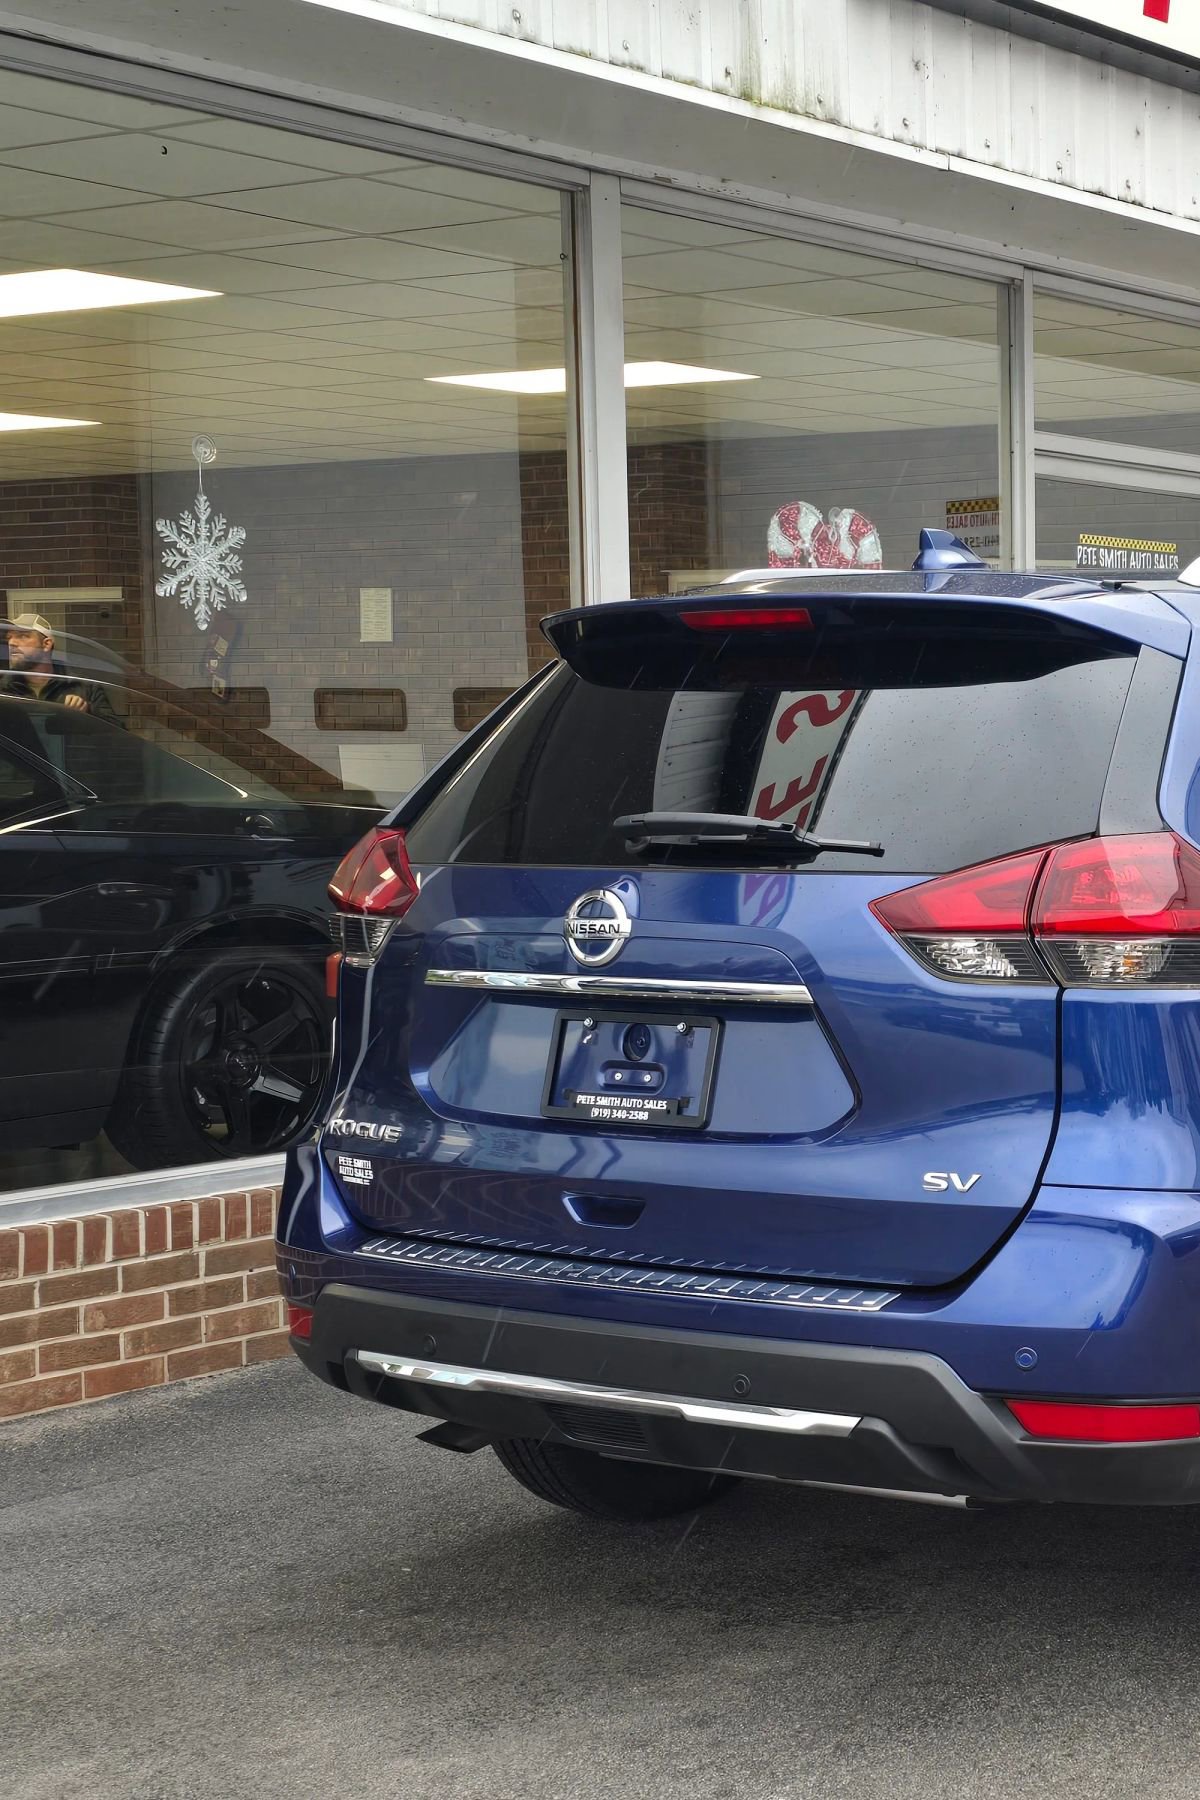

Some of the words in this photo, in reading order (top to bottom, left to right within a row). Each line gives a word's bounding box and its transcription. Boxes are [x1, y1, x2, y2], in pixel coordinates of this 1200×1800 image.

[1077, 545, 1097, 566] PETE
[1099, 548, 1128, 569] SMITH
[1129, 551, 1152, 569] AUTO
[1154, 553, 1179, 569] SALES
[568, 923, 620, 935] NISSAN
[576, 1094, 595, 1105] PETE
[596, 1095, 621, 1107] SMITH
[621, 1097, 643, 1109] AUTO
[643, 1099, 668, 1110] SALES
[591, 1107, 611, 1118] (919)
[611, 1109, 649, 1120] 340-2588
[330, 1118, 402, 1143] ROGUE
[922, 1172, 982, 1193] SV
